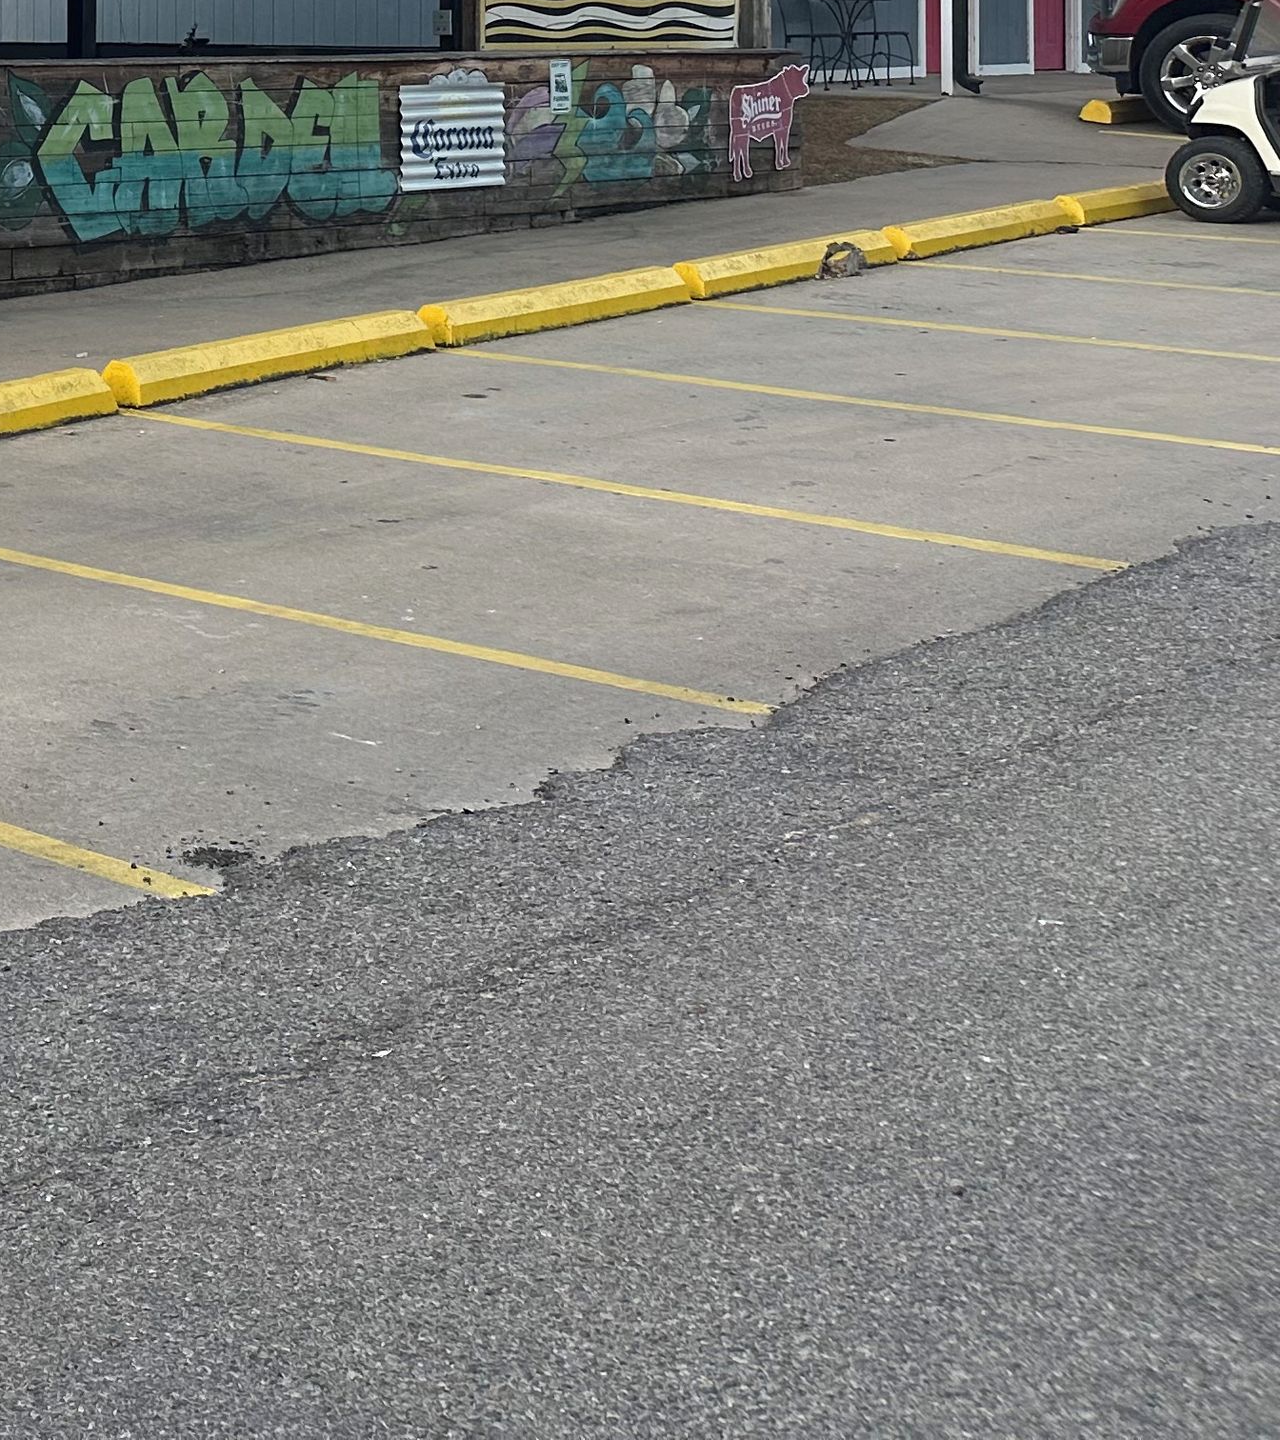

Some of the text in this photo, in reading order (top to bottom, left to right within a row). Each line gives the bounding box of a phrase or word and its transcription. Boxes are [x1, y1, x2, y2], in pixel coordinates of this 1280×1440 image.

[741, 92, 781, 129] Shiner
[410, 119, 494, 159] Corona
[430, 157, 480, 180] Extra
